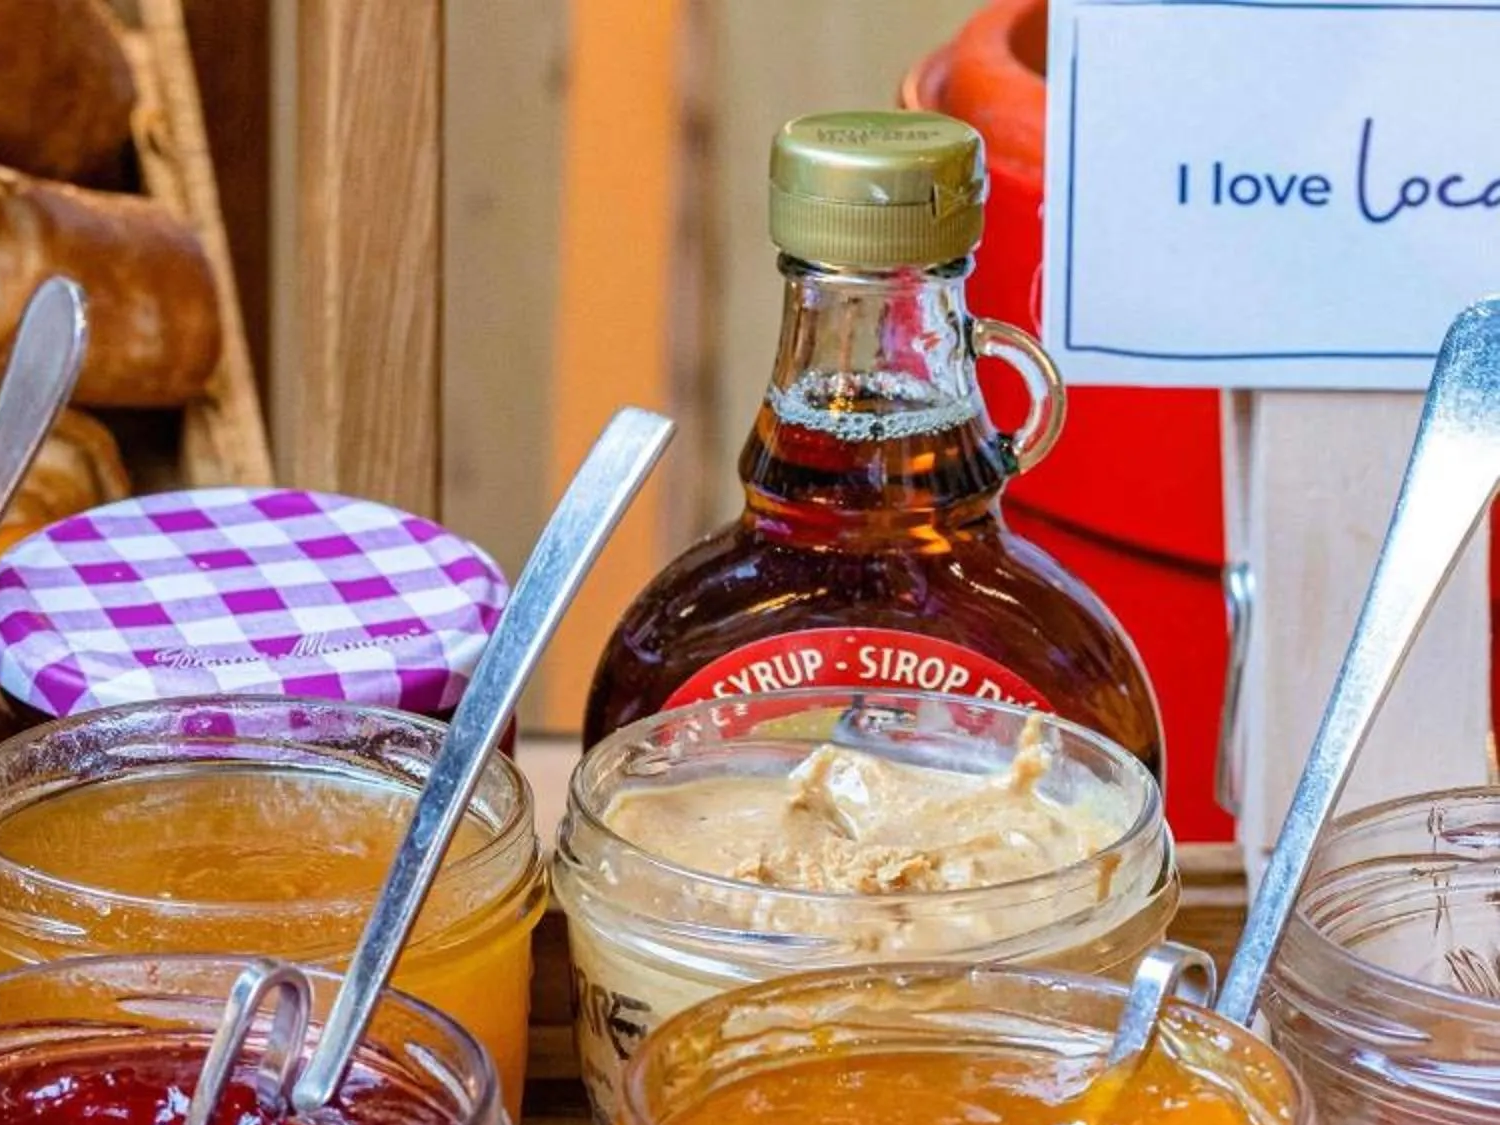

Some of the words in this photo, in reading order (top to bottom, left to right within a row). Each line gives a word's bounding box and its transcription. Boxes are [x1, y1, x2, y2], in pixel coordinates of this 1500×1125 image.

[1177, 164, 1190, 205] I
[1212, 161, 1332, 206] love
[712, 648, 823, 699] SYRUP
[858, 645, 970, 694] SIROP
